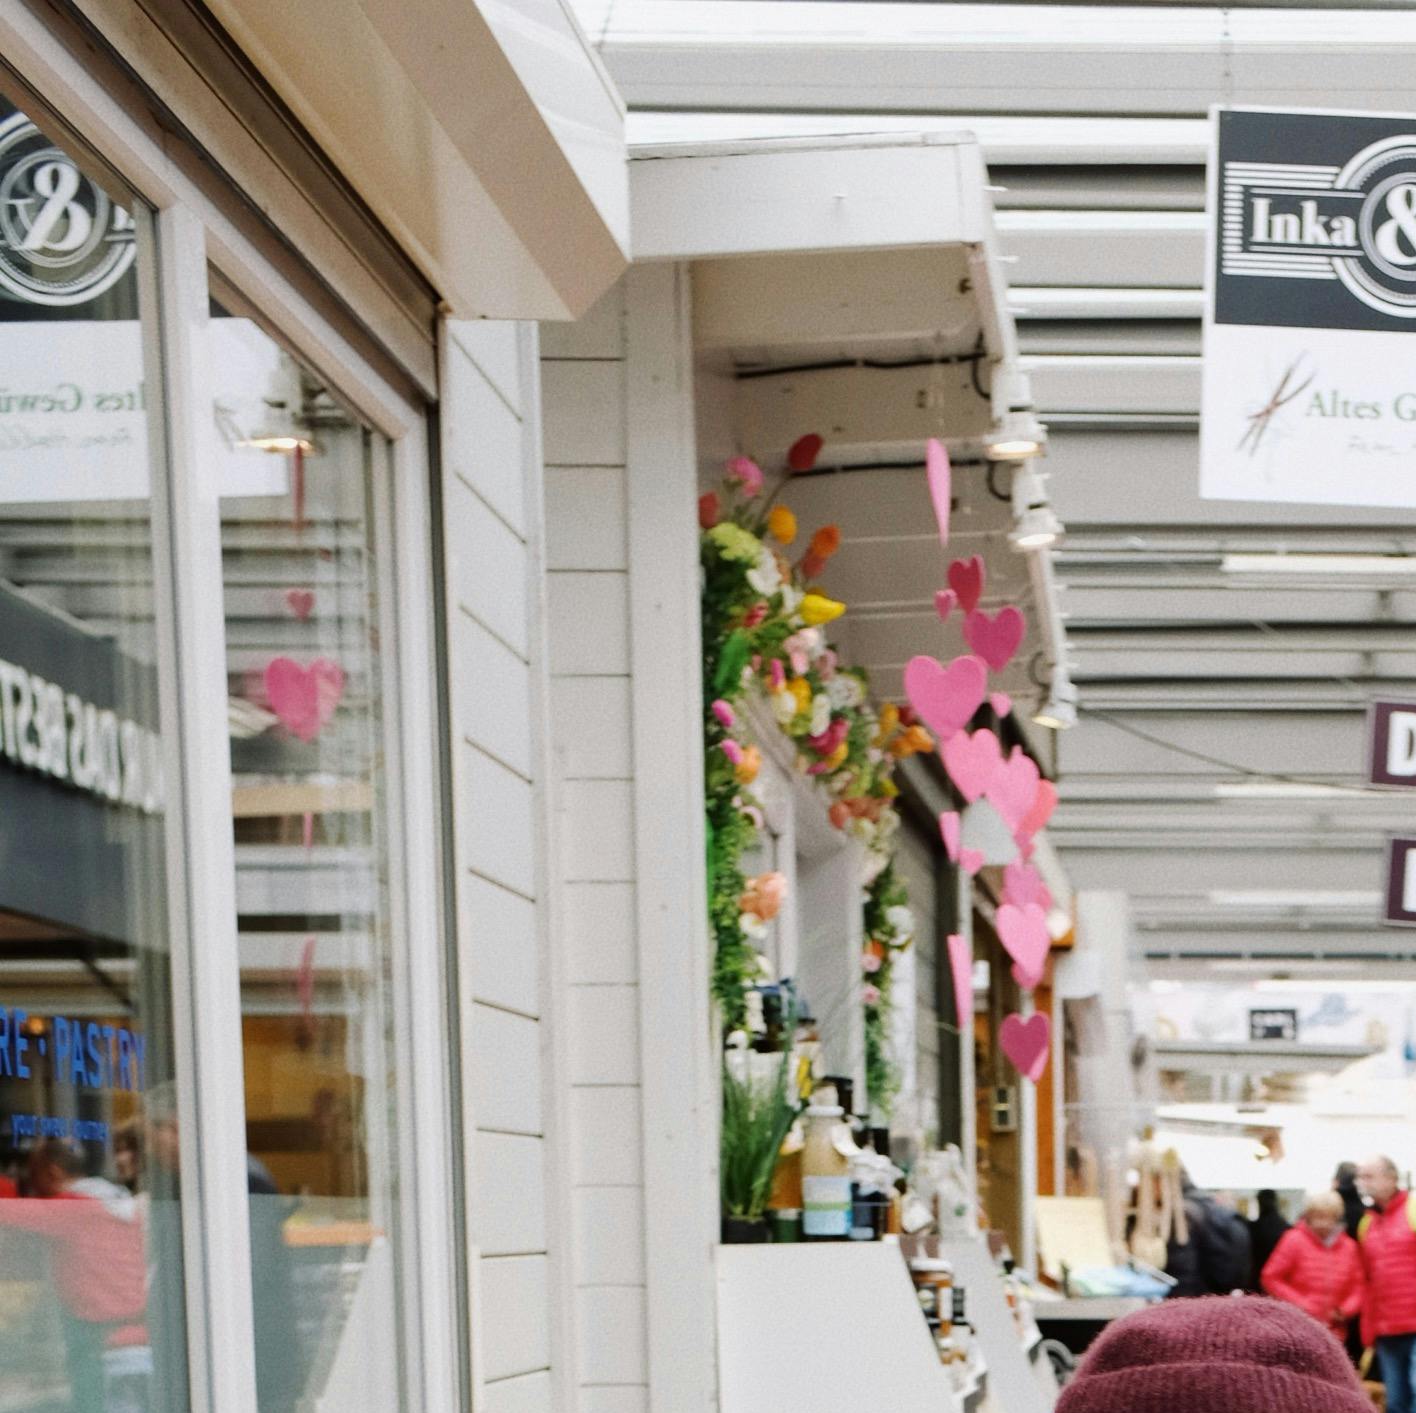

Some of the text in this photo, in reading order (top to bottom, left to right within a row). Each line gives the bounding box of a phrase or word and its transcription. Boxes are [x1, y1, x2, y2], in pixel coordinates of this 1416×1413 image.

[1251, 197, 1358, 248] Inka
[1305, 389, 1382, 421] Altes
[54, 1016, 145, 1092] PASTRY
